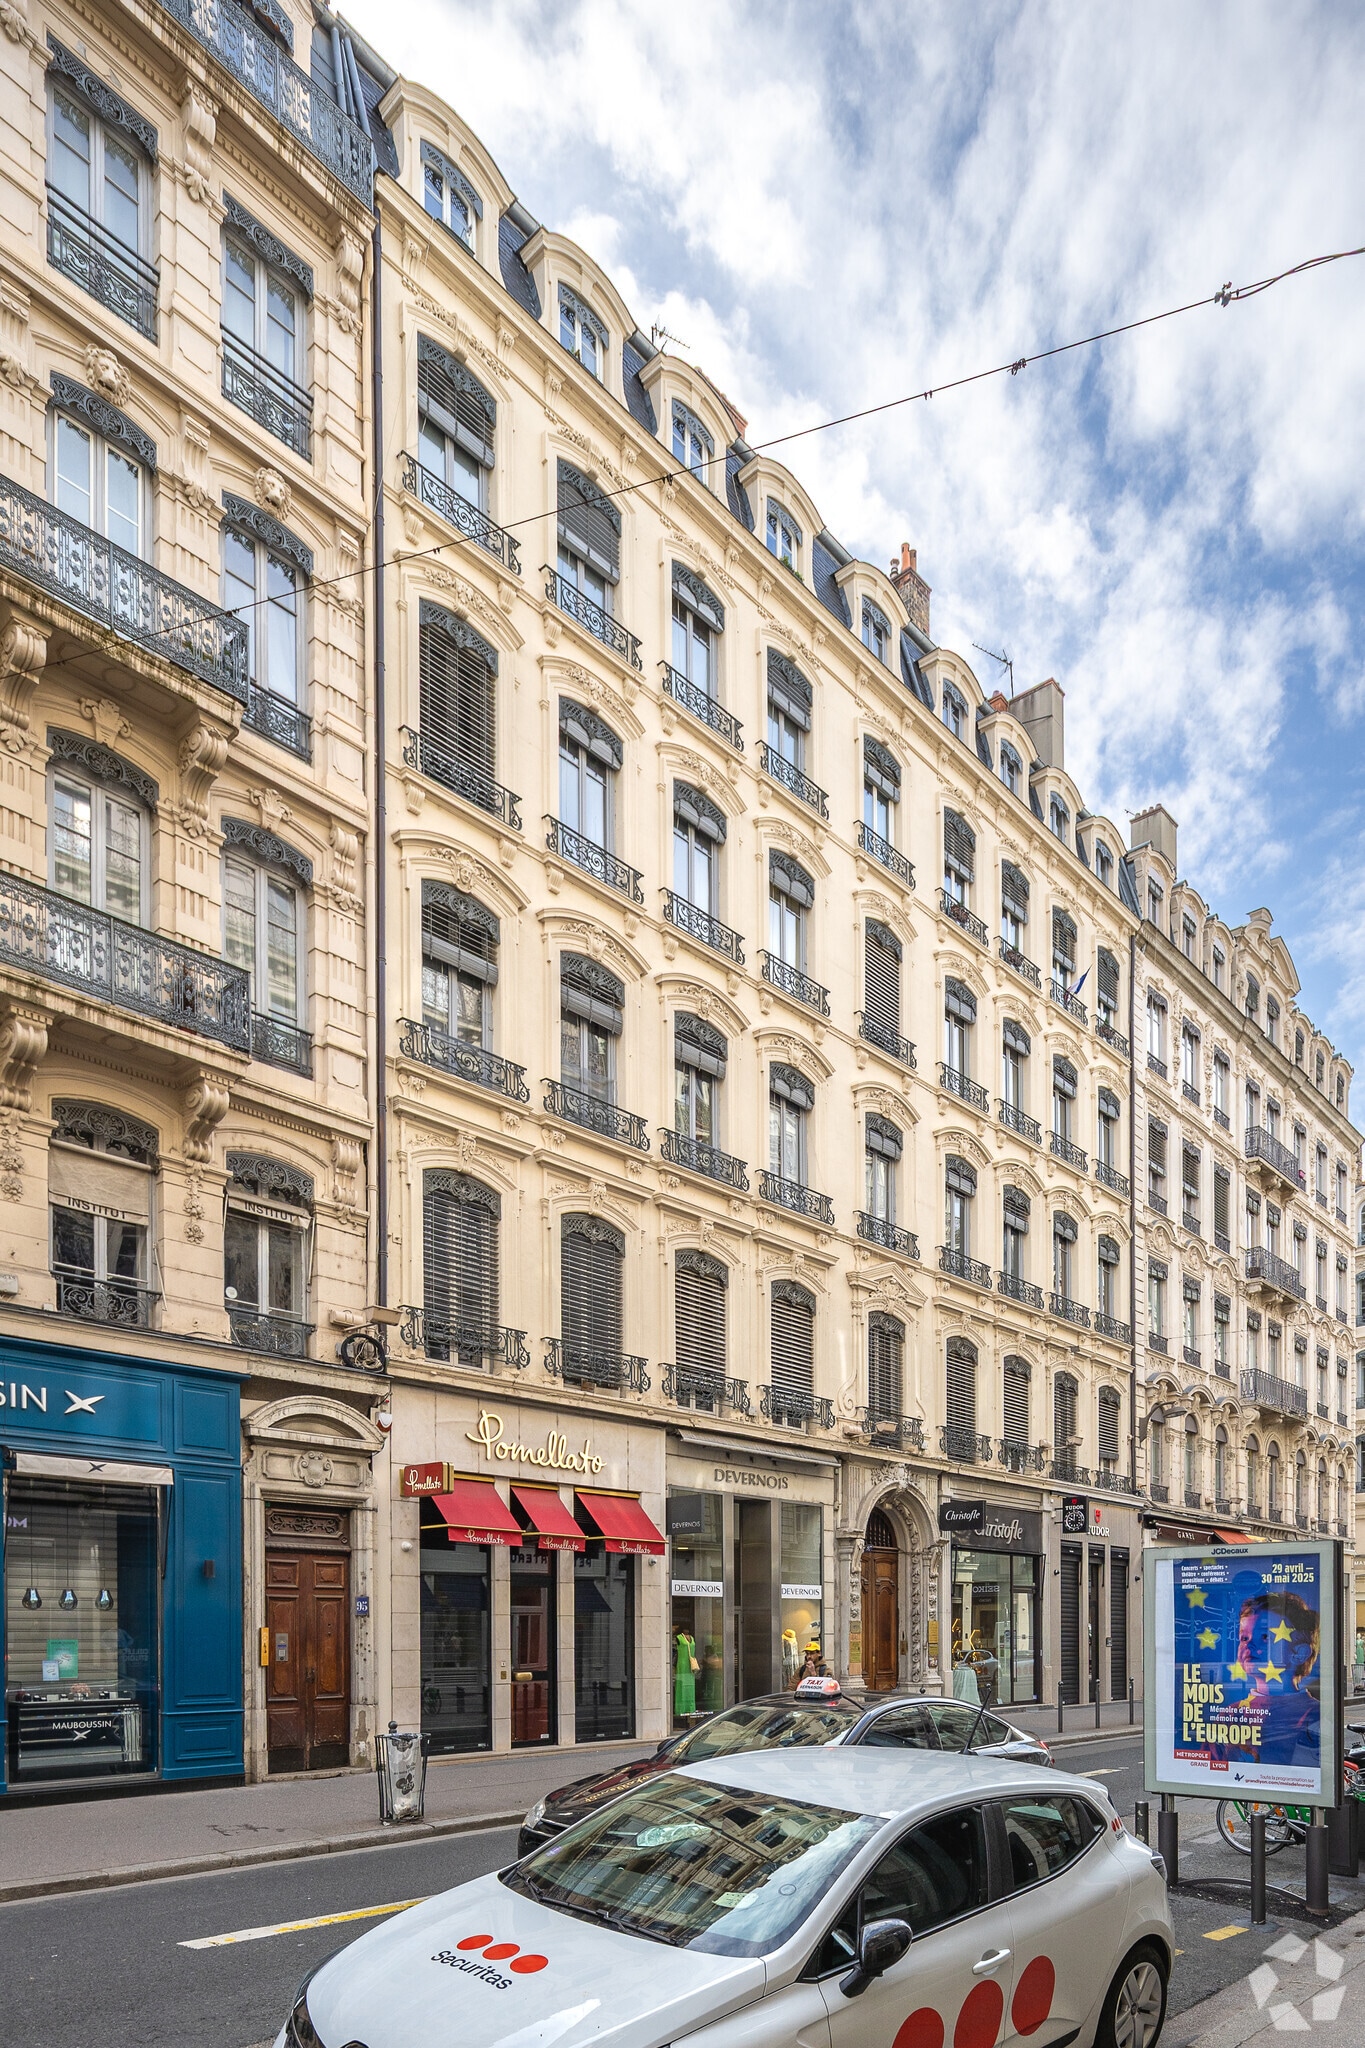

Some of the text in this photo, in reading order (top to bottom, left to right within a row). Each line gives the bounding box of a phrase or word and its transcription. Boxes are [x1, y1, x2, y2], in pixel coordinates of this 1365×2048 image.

[68, 1197, 127, 1220] INSTITUT
[244, 1201, 295, 1222] INSTITUT
[465, 1409, 607, 1474] Pomellato
[405, 1469, 442, 1493] Pomellato
[714, 1468, 789, 1490] DEVERNOIS
[945, 1509, 981, 1522] Christofle
[671, 1520, 701, 1529] DEVERNOIS
[464, 1529, 505, 1545] Pomellato
[543, 1536, 580, 1551] Pomellato
[619, 1541, 651, 1554] Pomellato
[1272, 1562, 1304, 1574] 29 avril
[1261, 1572, 1315, 1584] 30 mai 2025
[674, 1584, 721, 1593] DEVERNOIS
[781, 1587, 820, 1596] DEVERNOIS
[356, 1601, 368, 1612] 95
[1183, 1663, 1201, 1683] LE
[1183, 1683, 1225, 1704] MOIS
[1183, 1703, 1203, 1723] DE
[1209, 1705, 1271, 1716] Mémoire d'Europe,
[52, 1720, 112, 1730] MAUBOUSSIN
[1209, 1714, 1263, 1724] mémoire de paix
[1182, 1722, 1262, 1746] L'EUROPE
[430, 1950, 513, 1990] Securitas
